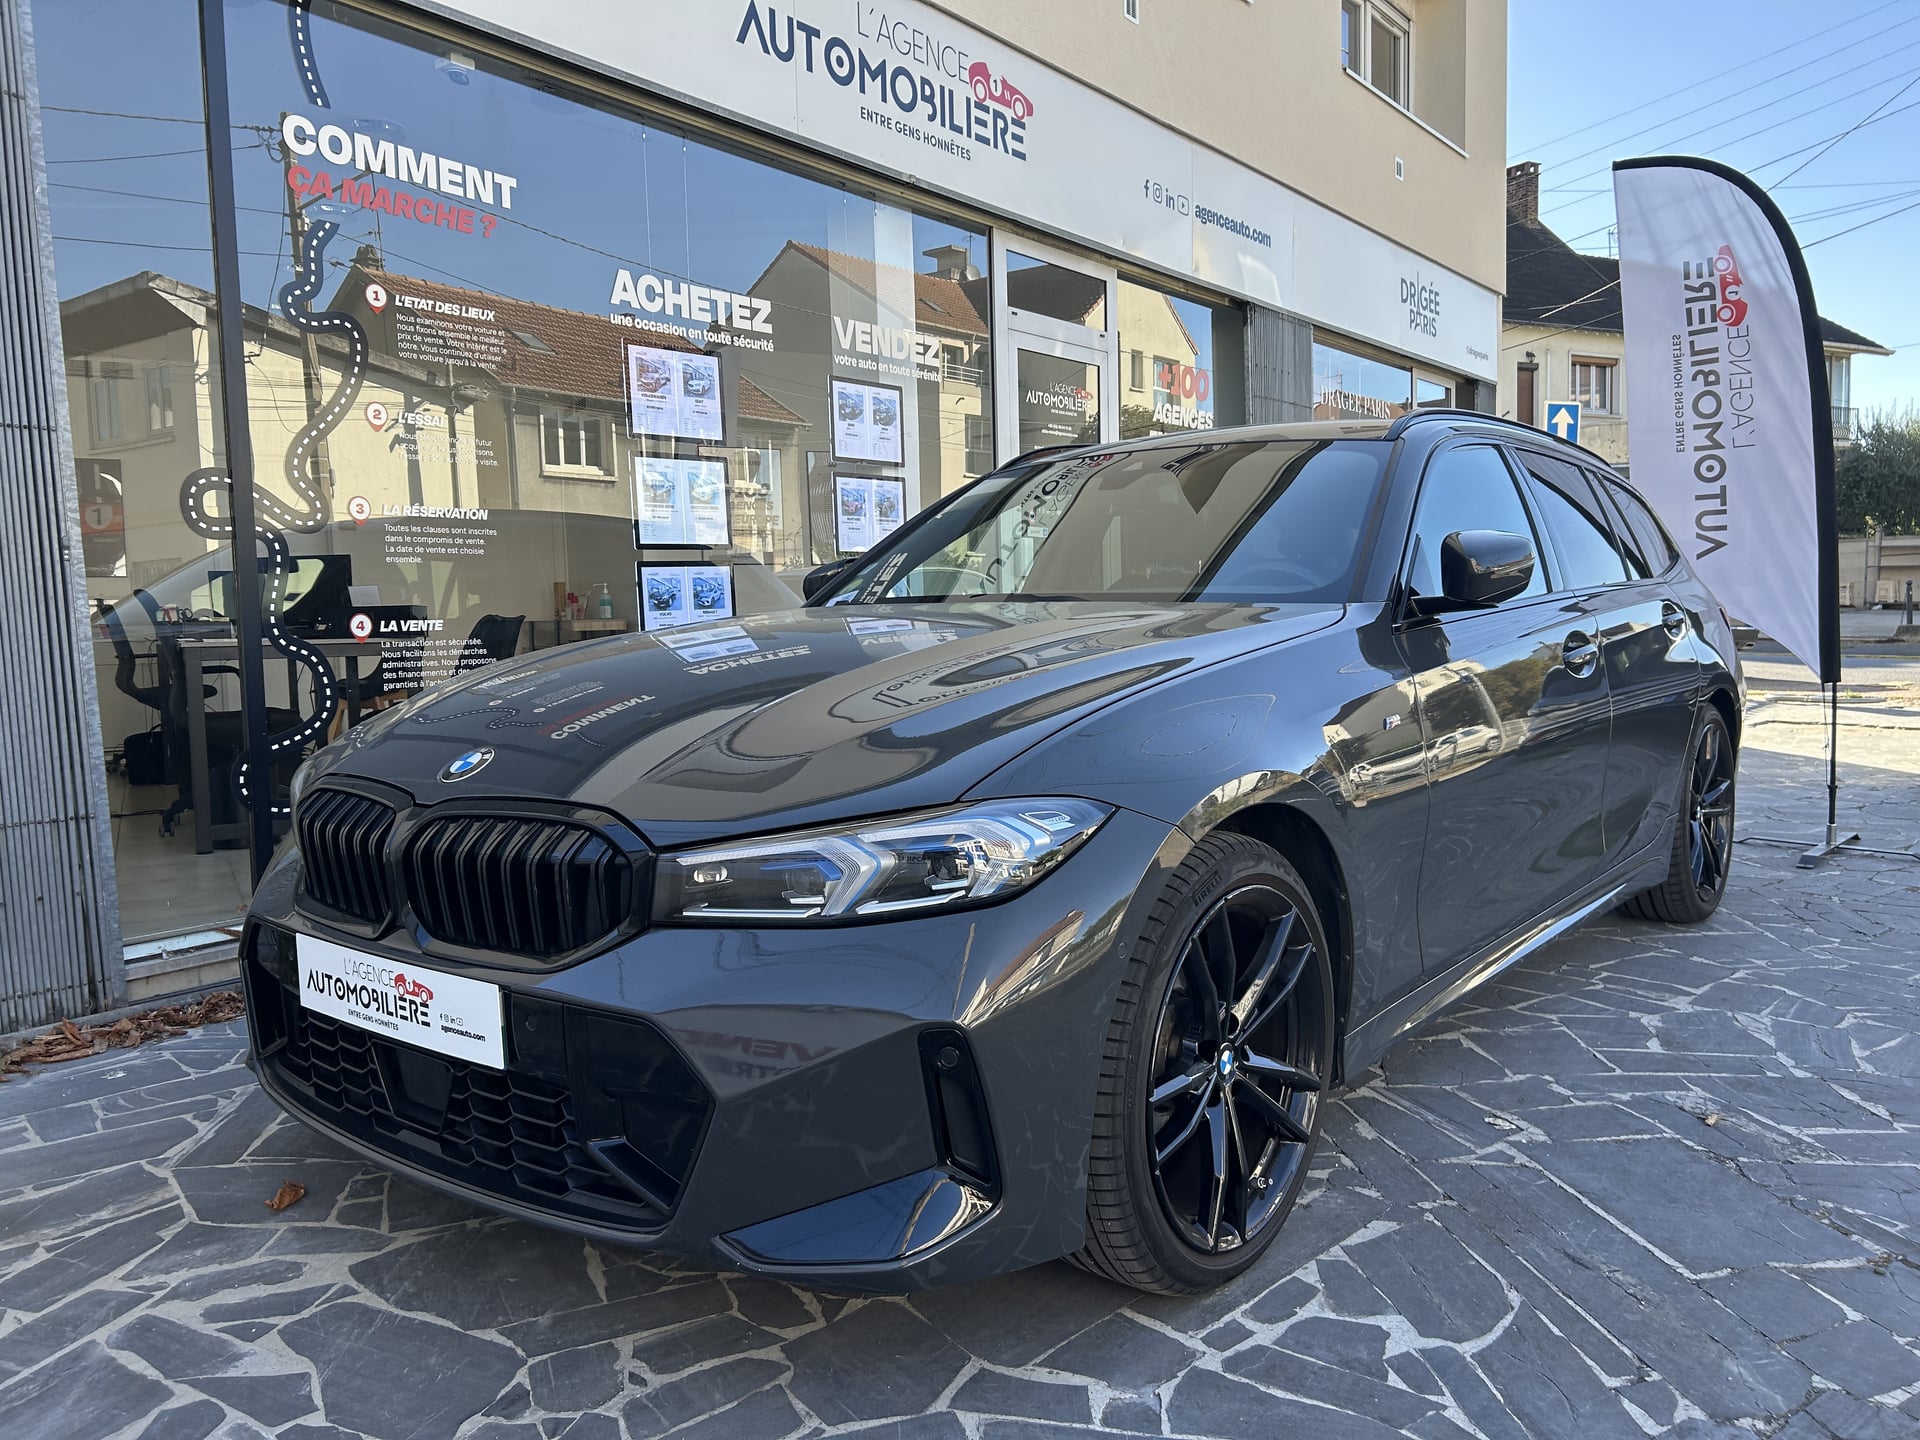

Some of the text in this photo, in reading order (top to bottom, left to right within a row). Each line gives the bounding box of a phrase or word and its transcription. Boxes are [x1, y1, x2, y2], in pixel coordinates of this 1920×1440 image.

[856, 1, 970, 85] L'AGENCE
[860, 106, 972, 161] ENTRE GENS HONNÊTES
[282, 114, 517, 209] COMMENT
[287, 165, 497, 239] ÇA MARCHE ?
[1195, 204, 1272, 248] agenceauto.com
[373, 290, 380, 302] 1
[610, 268, 773, 334] ACHETEZ
[395, 294, 496, 322] L'ETAT DES LIEUX
[396, 313, 506, 337] Nous examinons votre voiture et
[1409, 308, 1437, 338] PARIS
[397, 323, 505, 346] nous fixons ensemble le meilleur
[610, 313, 774, 353] une occasion en toute sécurité
[833, 316, 942, 368] VENDEZ
[397, 333, 507, 355] prix de vente. Votre intérêt est le
[398, 341, 419, 351] nôtre.
[420, 344, 438, 354] Vous
[439, 347, 472, 359] continuez
[398, 351, 498, 370] votre voiture jusqu'à la vente.
[833, 354, 942, 383] votre auto en toute sérénité
[1049, 381, 1077, 396] L'AGENCE
[1159, 363, 1210, 402] +100
[373, 409, 382, 420] 2
[1152, 401, 1214, 430] AGENCES
[1364, 396, 1391, 420] PARIS
[398, 411, 444, 428] L'ESSAI
[400, 432, 418, 441] Nous
[476, 439, 492, 447] futur
[479, 458, 499, 467] visite.
[92, 507, 102, 526] 1
[355, 503, 364, 514] 3
[383, 503, 489, 521] LA RÉSERVATION
[384, 524, 498, 536] Toutes les clauses sont inscrites
[384, 535, 486, 546] dans le compromis de vente.
[385, 544, 394, 553] La
[396, 545, 413, 554] date
[414, 545, 424, 554] de
[459, 546, 485, 556] choisie
[386, 555, 424, 564] ensemble.
[355, 620, 366, 632] 4
[379, 619, 444, 632] LA VENTE
[381, 638, 484, 648] La transaction est sécurisée.
[381, 647, 488, 659] Nous facilitons les démarches
[382, 656, 497, 669] administratives. Nous proposons
[382, 670, 397, 679] des
[398, 668, 448, 679] financements
[449, 668, 457, 676] et
[383, 681, 418, 692] garanties
[419, 679, 425, 688] à
[343, 957, 396, 988] L'AGENCE
[348, 1008, 362, 1019] ENTRE
[362, 1013, 374, 1024] GENS
[441, 1024, 486, 1042] agenceauto.com
